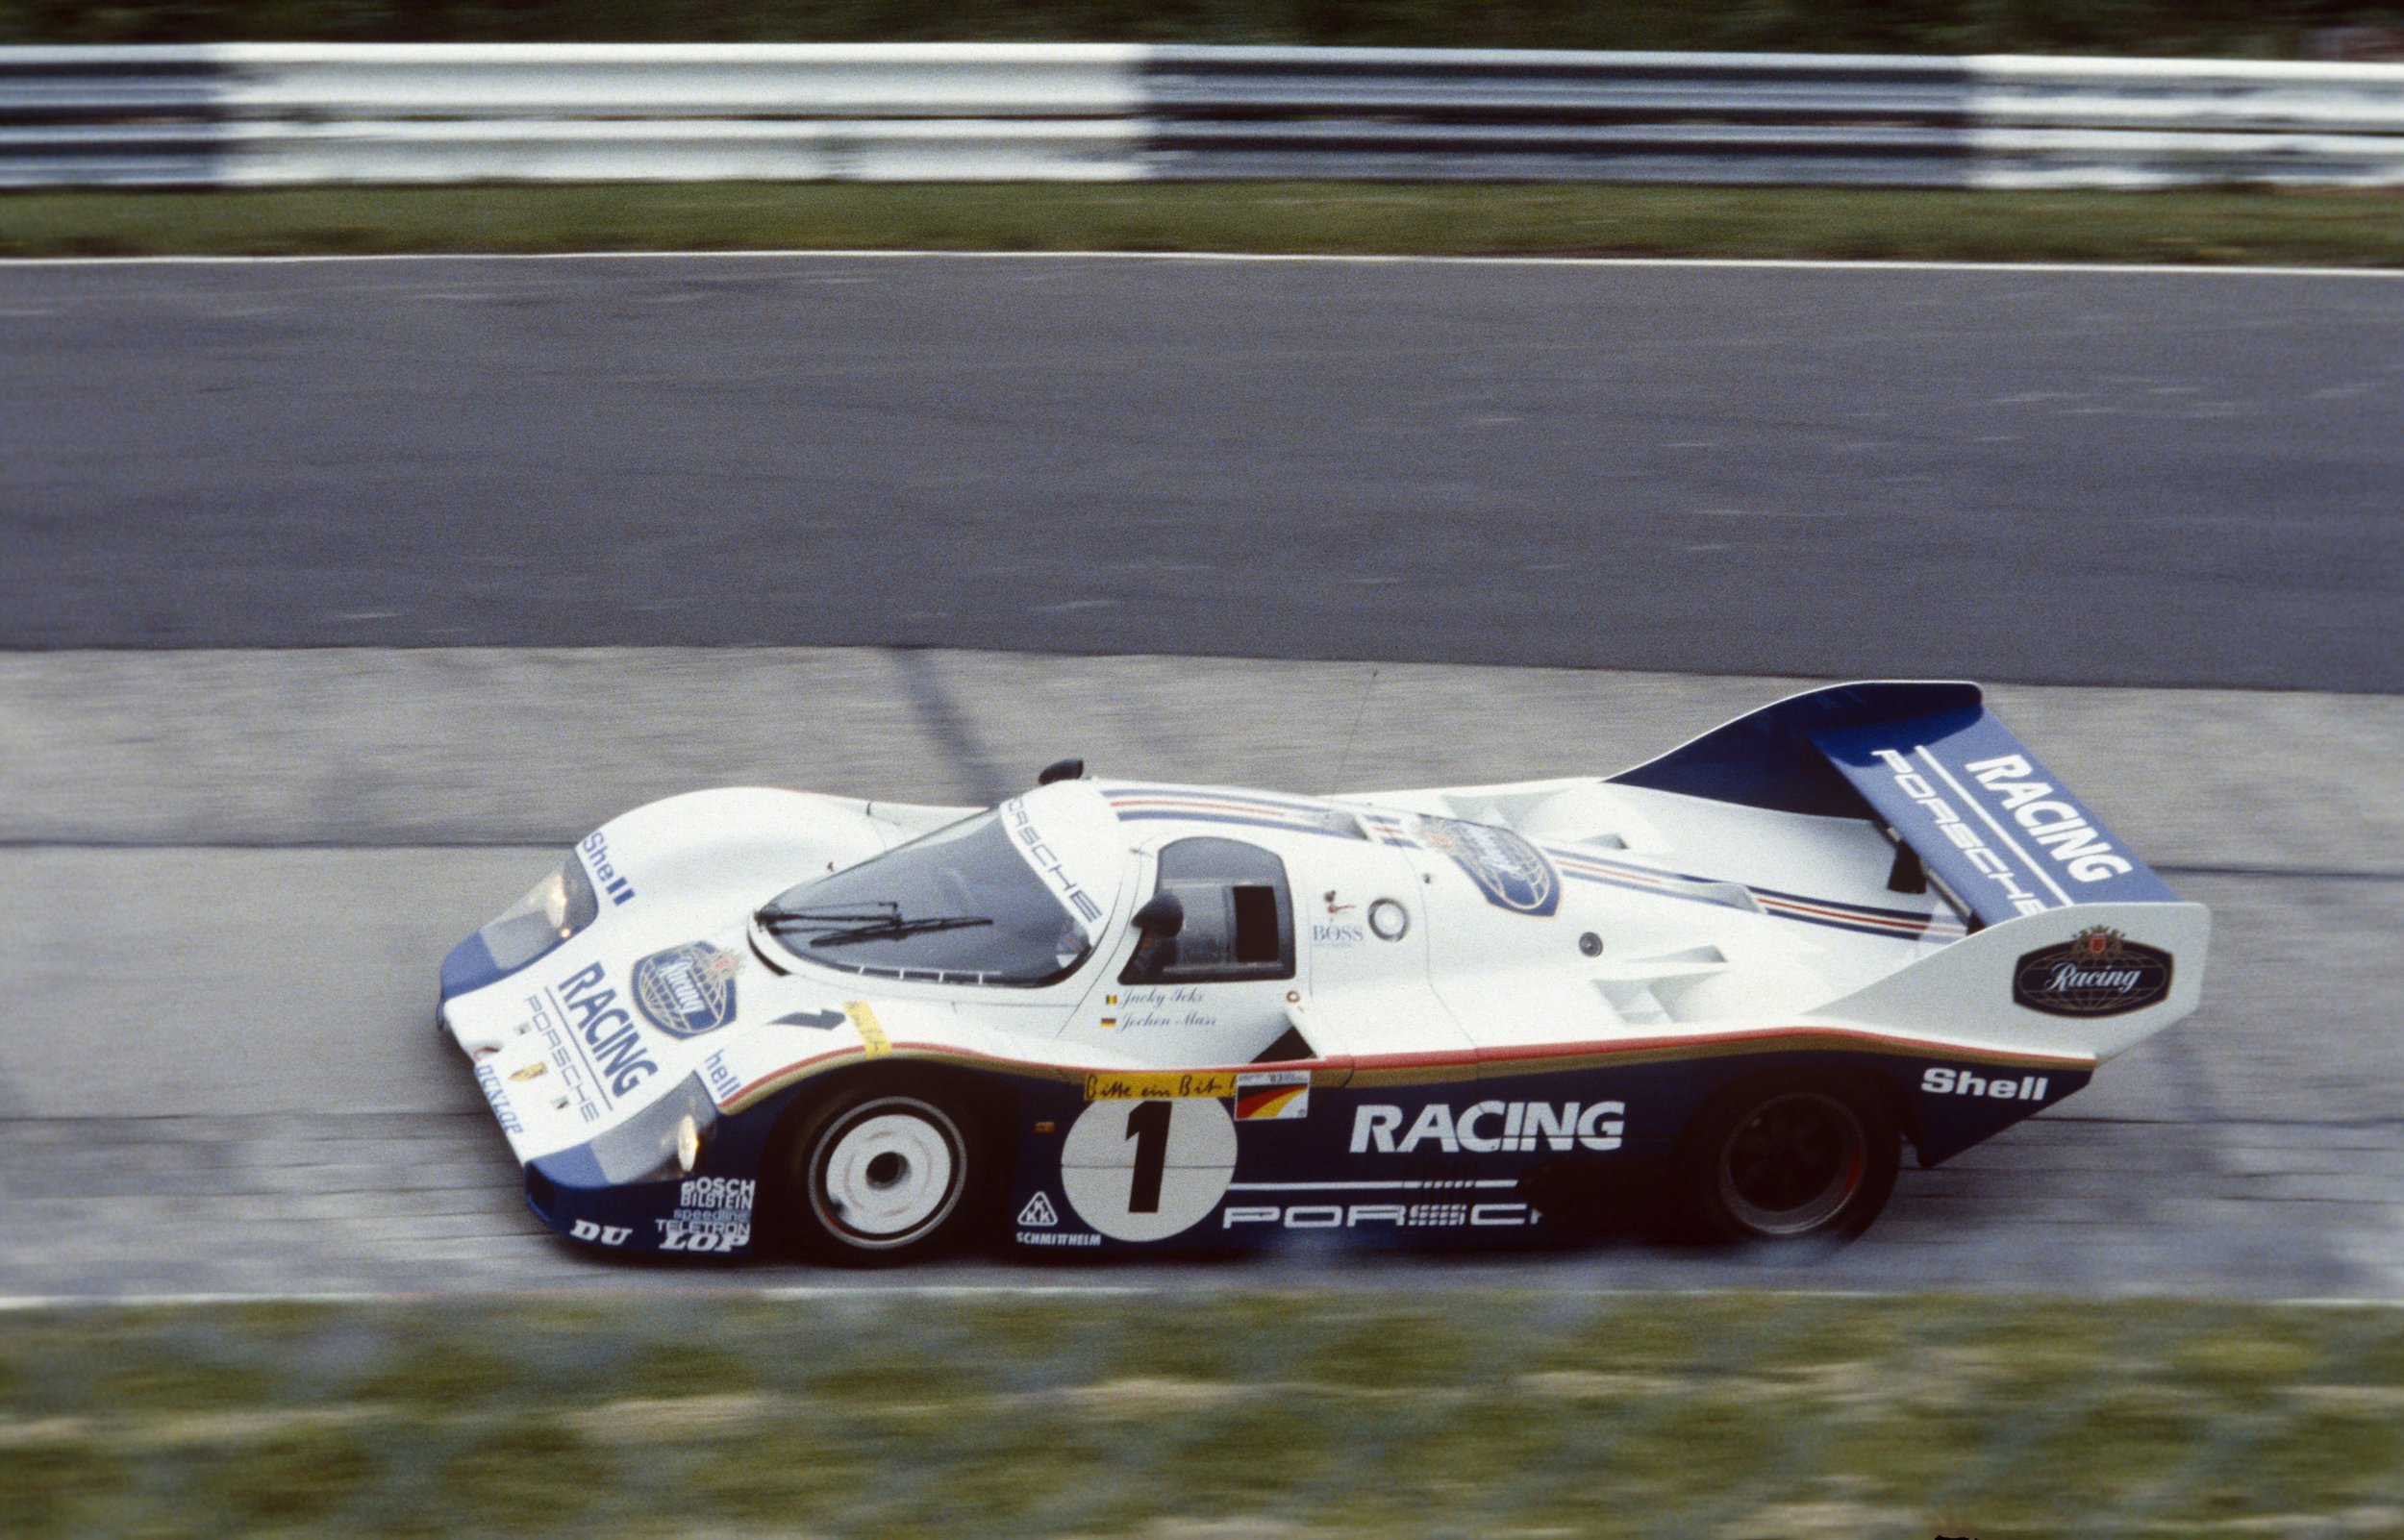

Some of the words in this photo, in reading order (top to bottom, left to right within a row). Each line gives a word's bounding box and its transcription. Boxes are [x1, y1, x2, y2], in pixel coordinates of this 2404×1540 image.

[1871, 749, 2047, 917] PORSCHE
[1966, 754, 2133, 882] RACING
[583, 832, 635, 906] Shell
[1008, 796, 1103, 923] ORSCHE
[1313, 926, 1364, 941] BOSS
[2043, 962, 2141, 993] Racing
[558, 961, 659, 1098] RACING
[1118, 1011, 1170, 1031] Jochen
[523, 994, 600, 1123] PORSCHE
[1086, 1074, 1132, 1099] Bitte
[1140, 1083, 1171, 1098] ein
[1920, 1067, 2048, 1102] Shell
[1349, 1100, 1625, 1154] RACING
[1125, 1101, 1172, 1213] 1
[680, 1192, 752, 1209] BILSTEIN
[681, 1177, 756, 1196] BOSCH
[655, 1218, 750, 1236] TELETRON
[1223, 1203, 1544, 1230] PORSC
[1015, 1231, 1102, 1246] SCHMITTHELM
